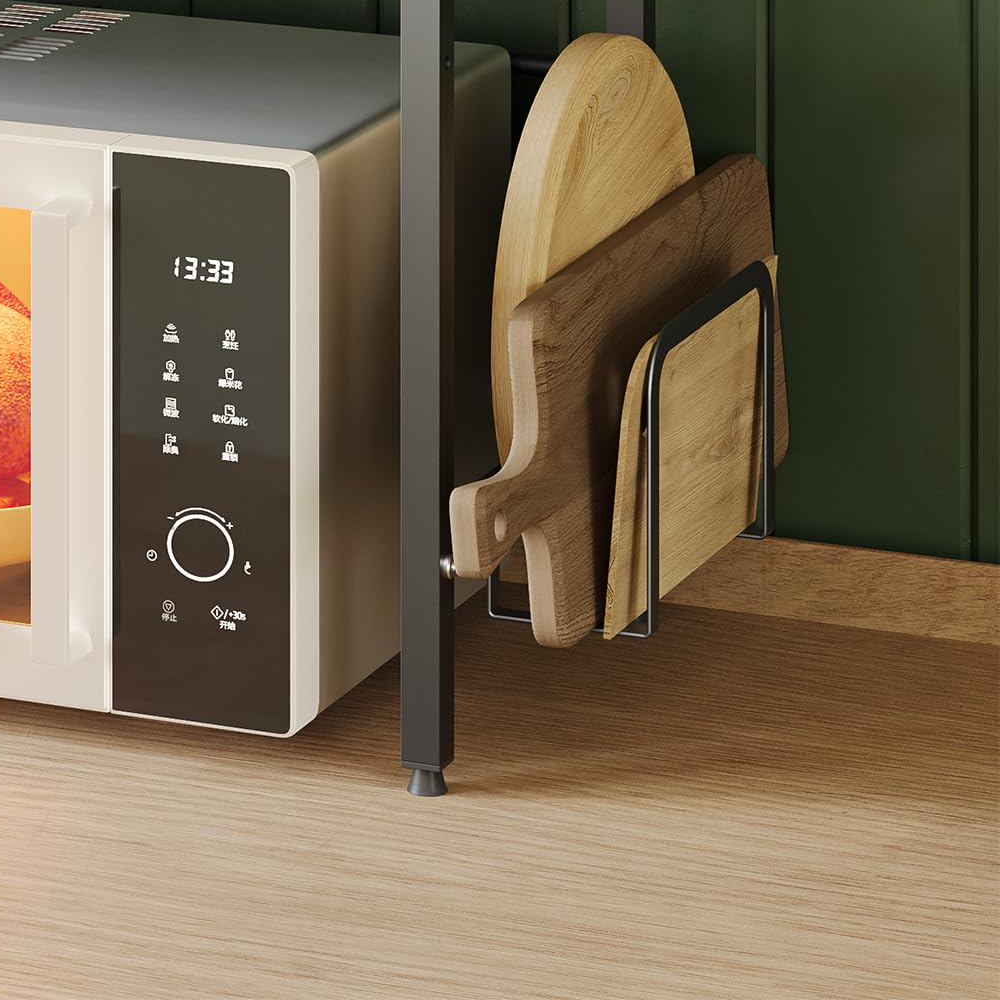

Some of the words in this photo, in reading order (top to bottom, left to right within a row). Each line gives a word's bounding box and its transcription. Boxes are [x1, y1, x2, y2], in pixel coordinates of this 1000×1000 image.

[173, 256, 234, 284] 13:33
[161, 613, 177, 622] 停止
[219, 620, 236, 631] 开始
